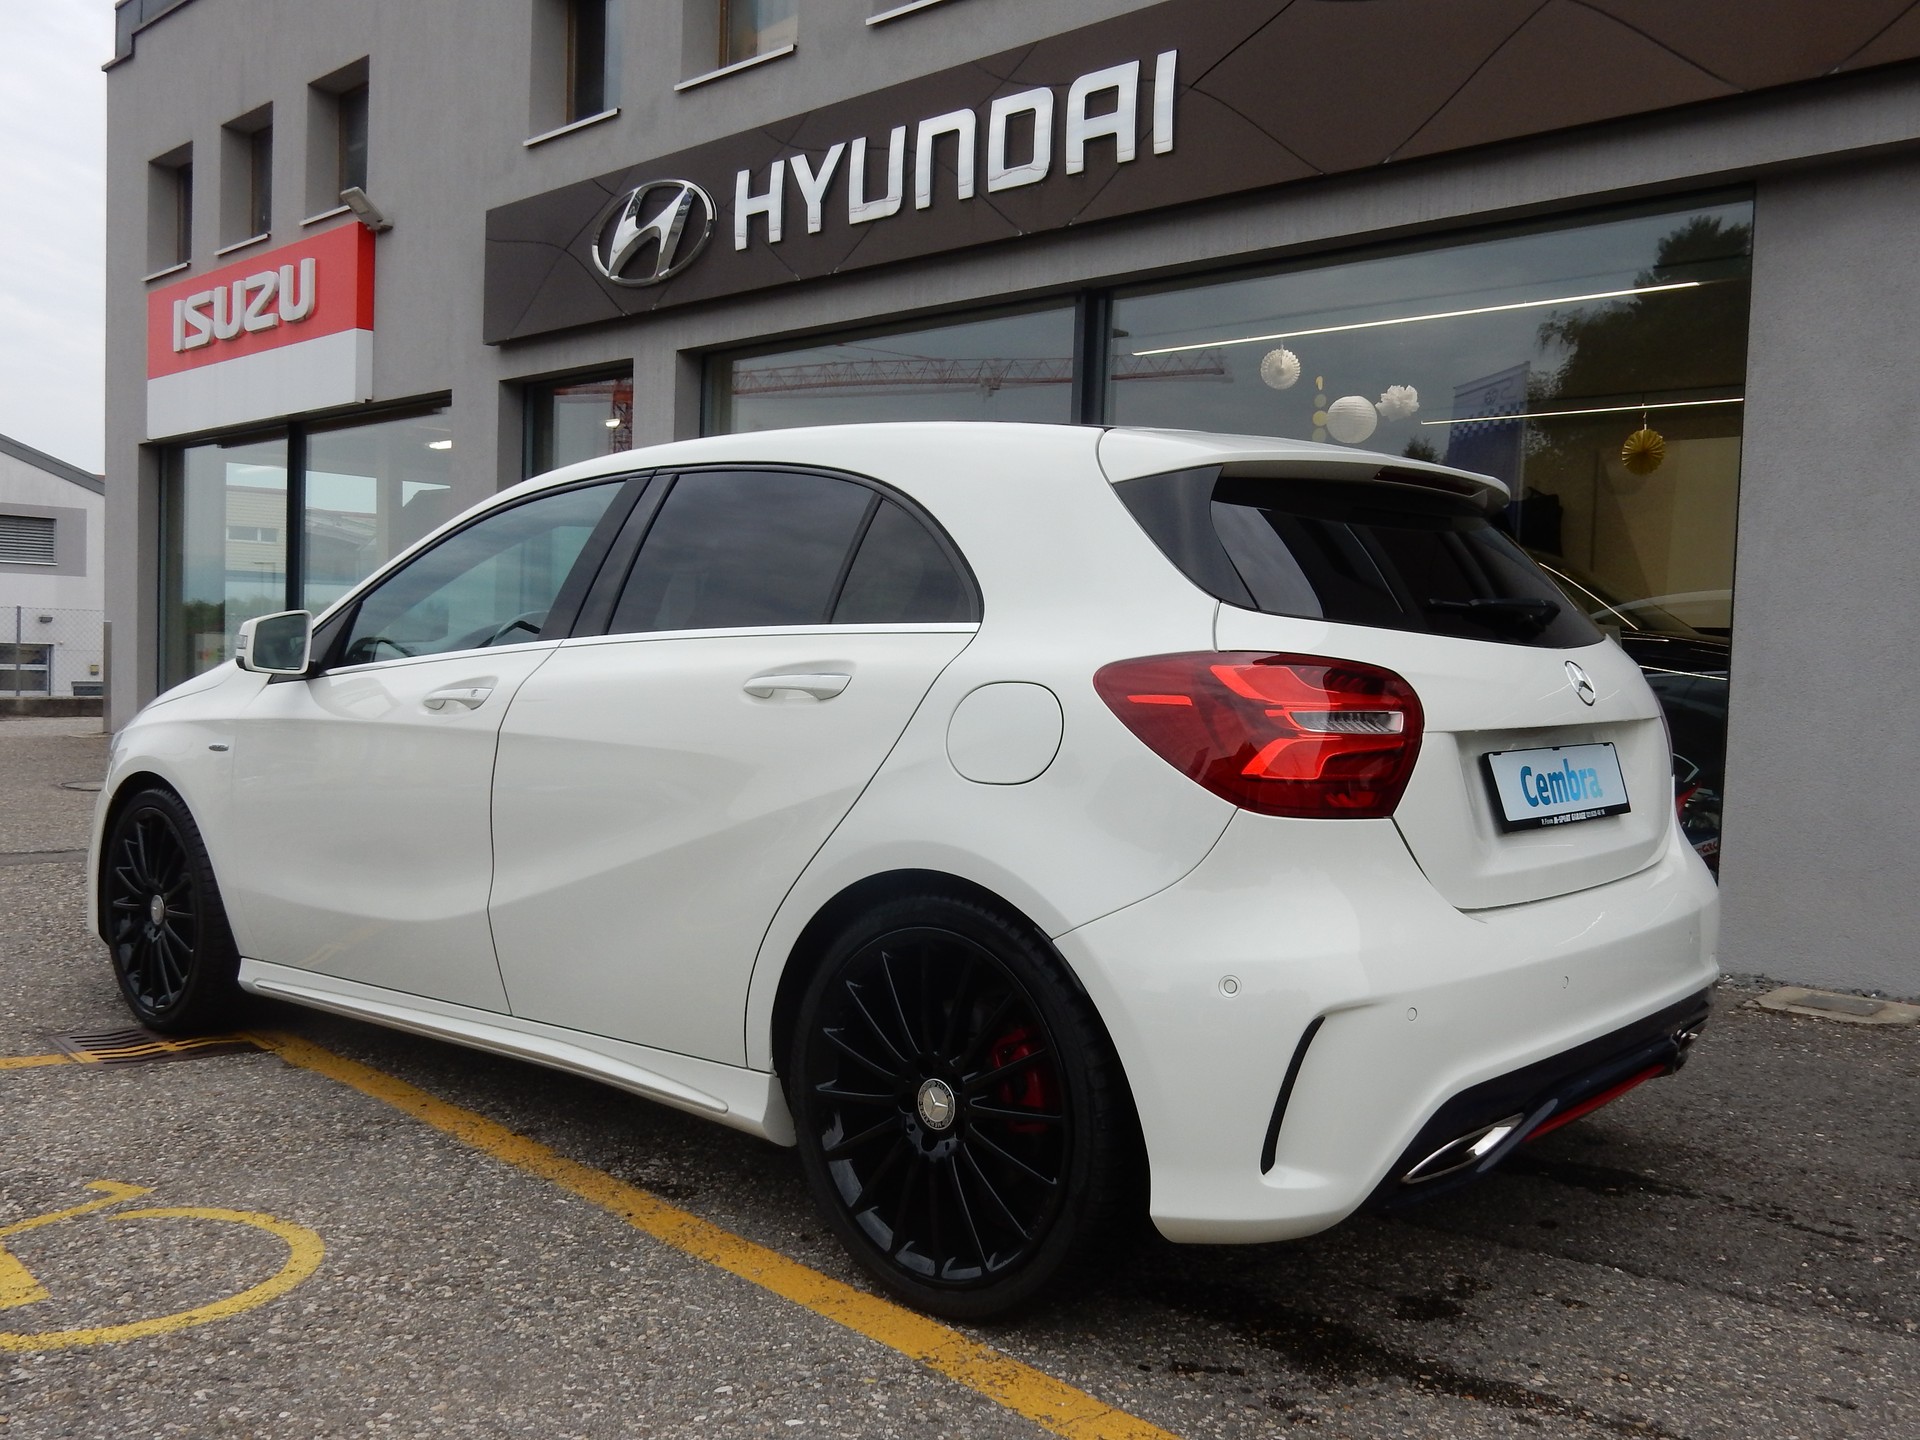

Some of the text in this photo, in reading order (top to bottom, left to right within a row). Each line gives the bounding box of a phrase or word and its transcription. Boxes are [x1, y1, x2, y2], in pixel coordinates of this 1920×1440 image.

[734, 50, 1177, 251] HYUNDAI
[173, 258, 316, 353] ISUZU
[1520, 758, 1603, 807] Cembra
